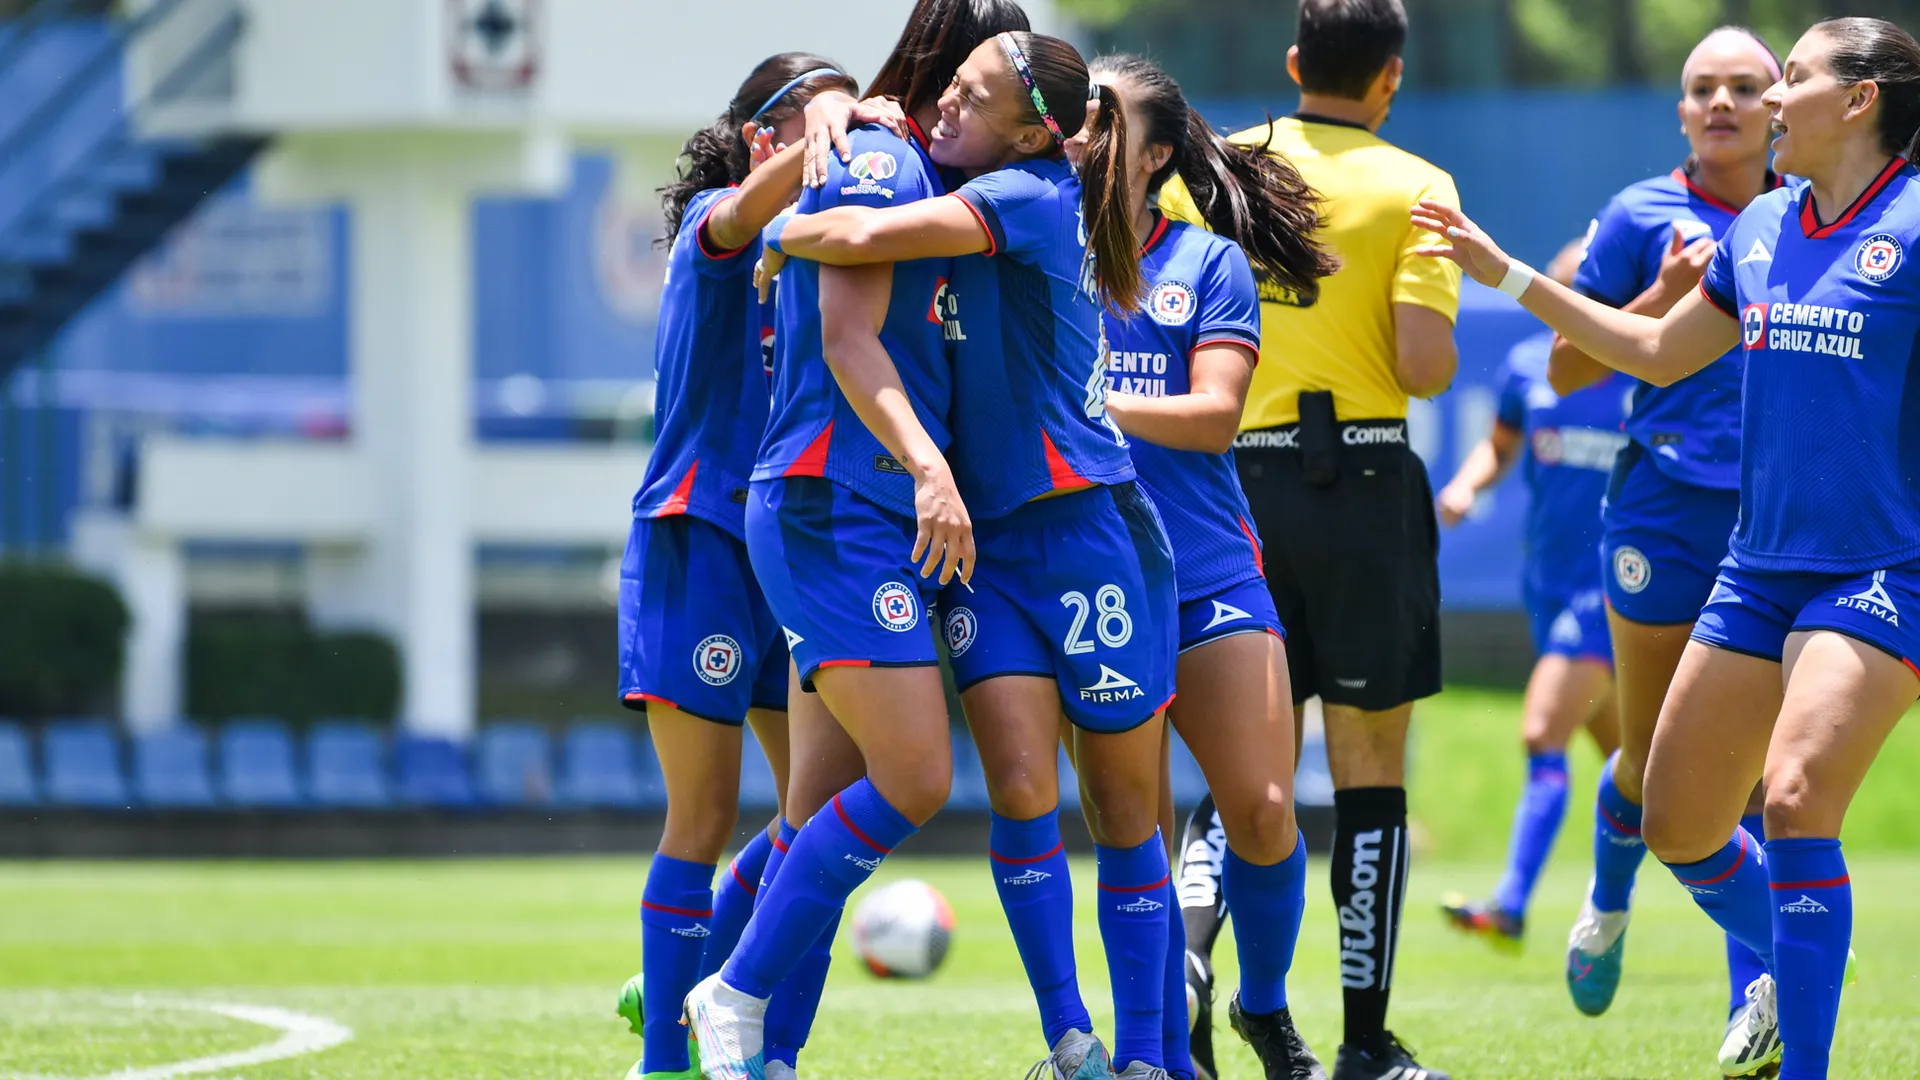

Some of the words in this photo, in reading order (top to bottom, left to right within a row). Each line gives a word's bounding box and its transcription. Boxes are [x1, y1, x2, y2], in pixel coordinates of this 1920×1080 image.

[1770, 302, 1864, 334] CEMENTO
[1769, 328, 1812, 353] CRUZ
[1814, 332, 1864, 360] AZUL
[1108, 350, 1167, 375] ENTO
[1119, 376, 1170, 398] AZUL
[1059, 583, 1133, 655] 28
[1834, 596, 1899, 628] PIRMA
[1080, 686, 1145, 703] PIRMA
[1339, 828, 1383, 990] Wilson
[1780, 905, 1829, 914] PIRMA
